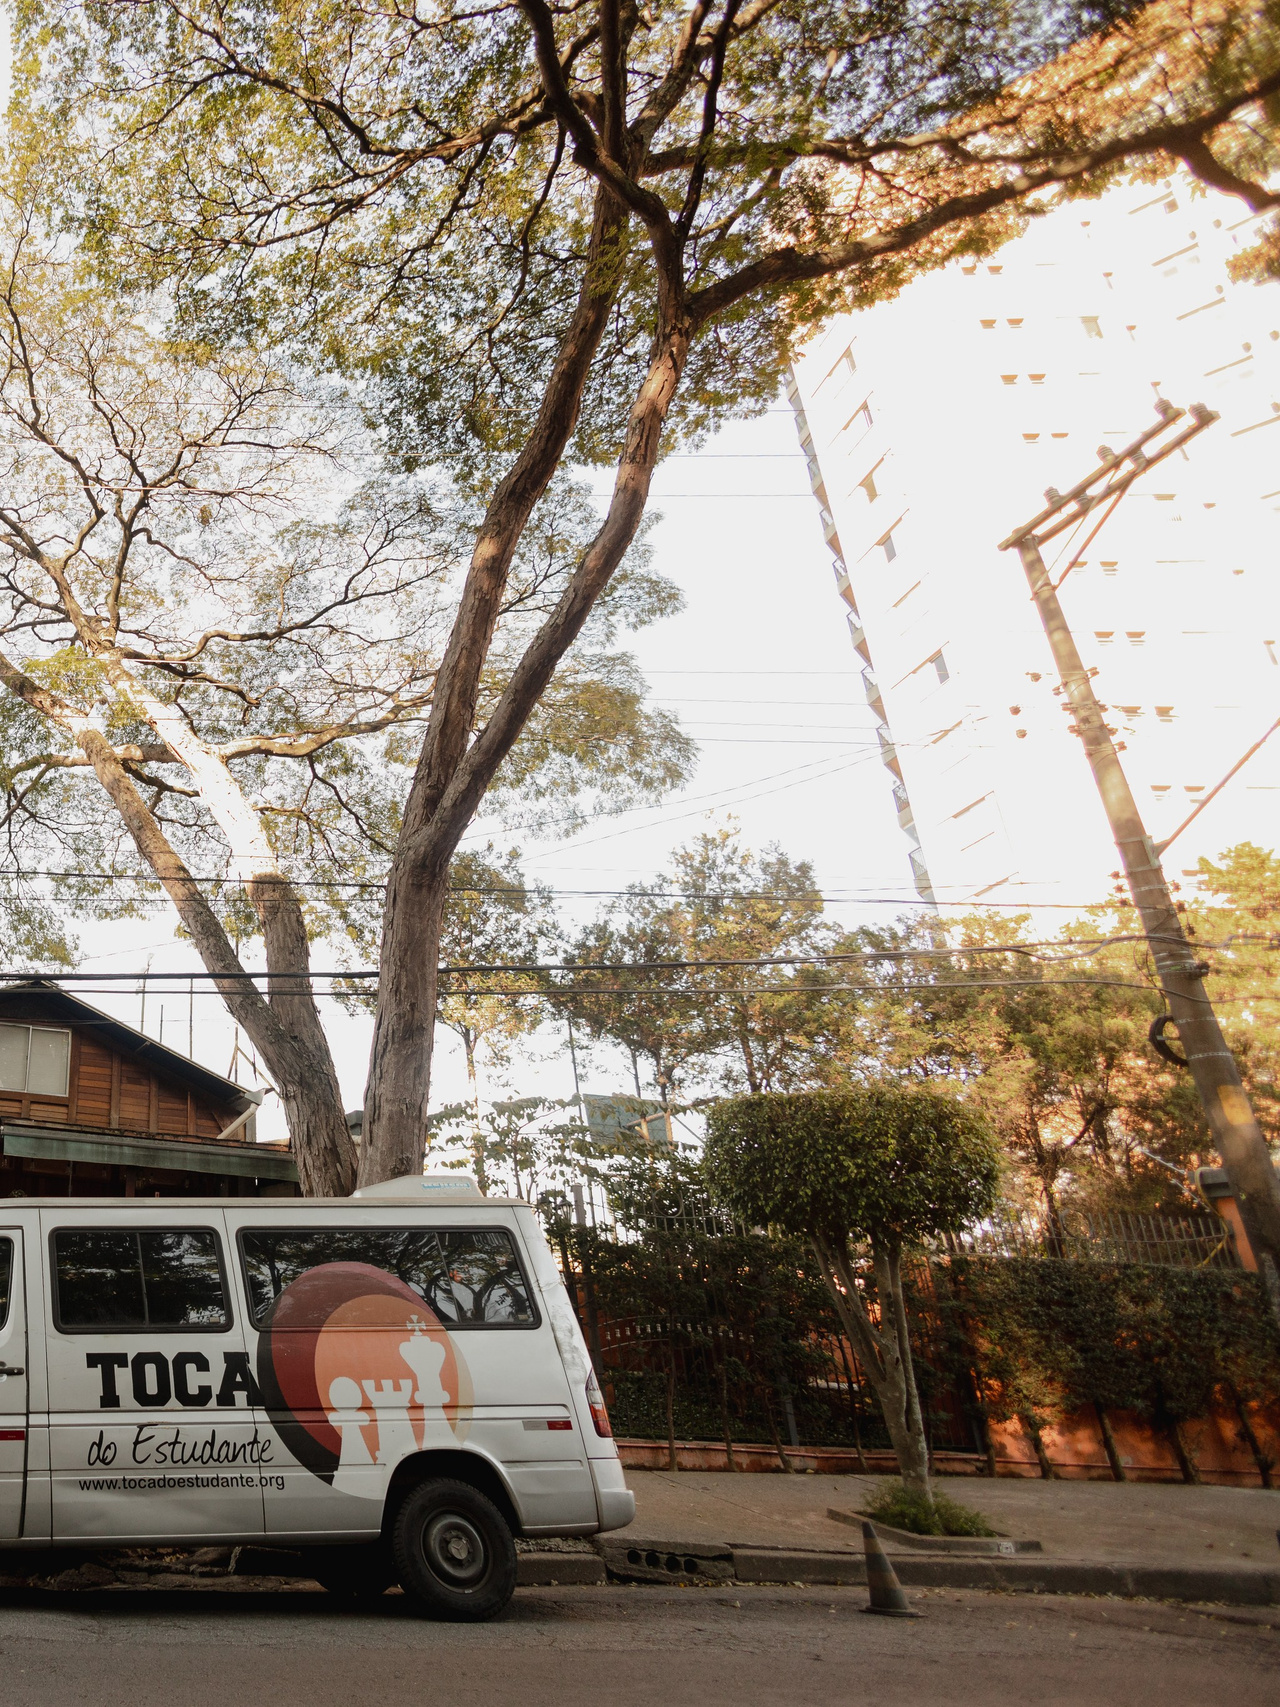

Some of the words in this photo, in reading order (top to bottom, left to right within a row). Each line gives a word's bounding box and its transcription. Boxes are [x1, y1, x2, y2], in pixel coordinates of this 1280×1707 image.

[86, 1351, 266, 1408] TOCA
[87, 1429, 117, 1466] do
[132, 1423, 274, 1465] Estudante
[78, 1473, 285, 1491] www.tocadoestudante.org
